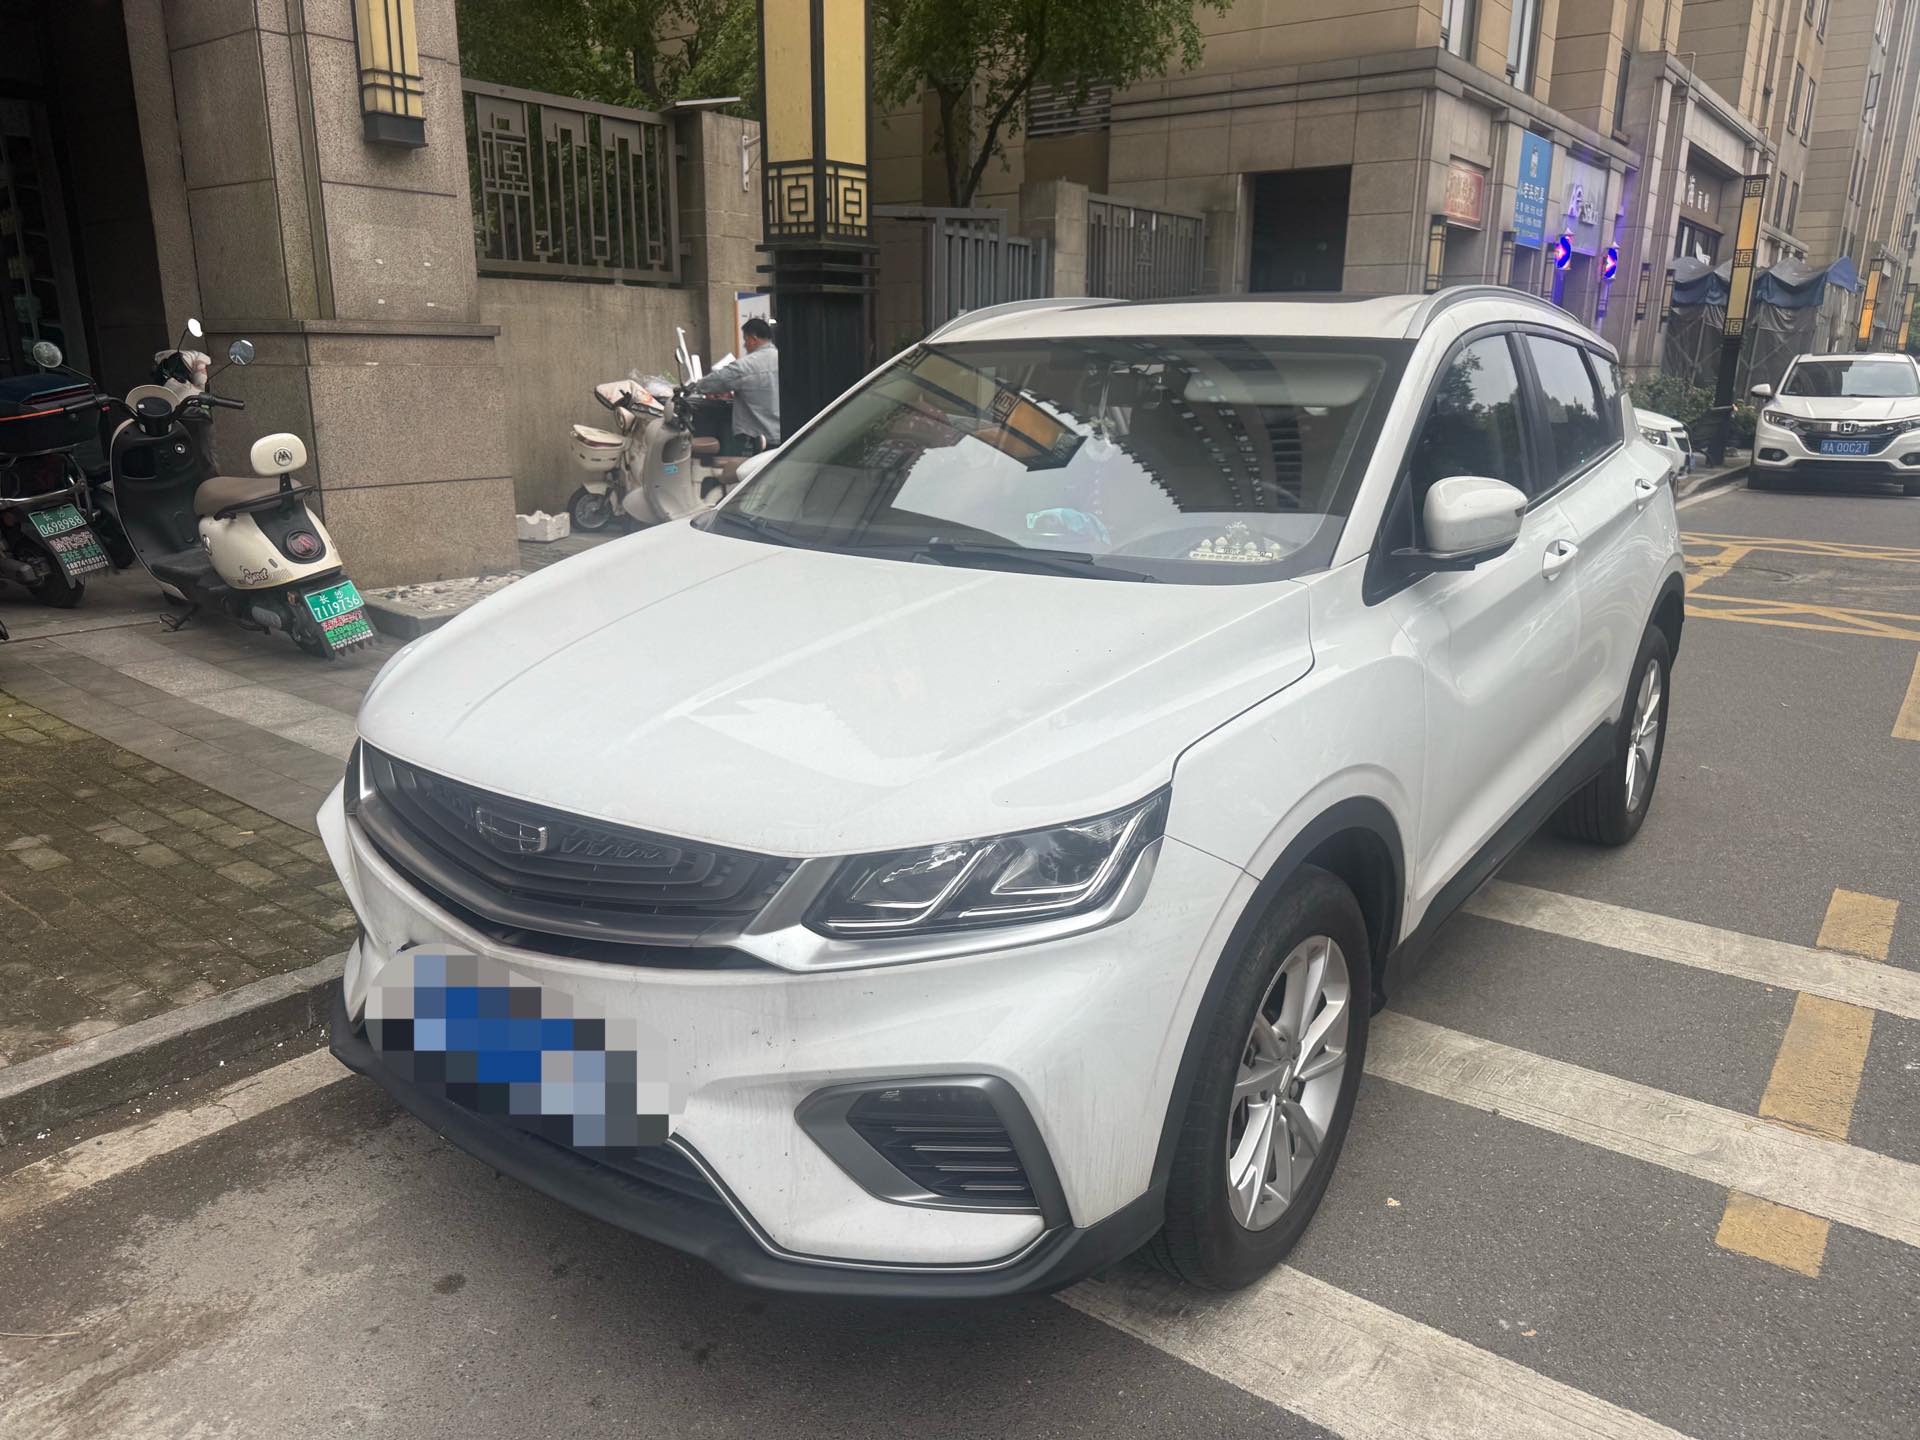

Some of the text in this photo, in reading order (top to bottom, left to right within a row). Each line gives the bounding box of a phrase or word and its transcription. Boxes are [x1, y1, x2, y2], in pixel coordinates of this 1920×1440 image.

[40, 515, 83, 535] 0698988
[319, 588, 344, 604] 长沙
[314, 594, 360, 620] 7119736
